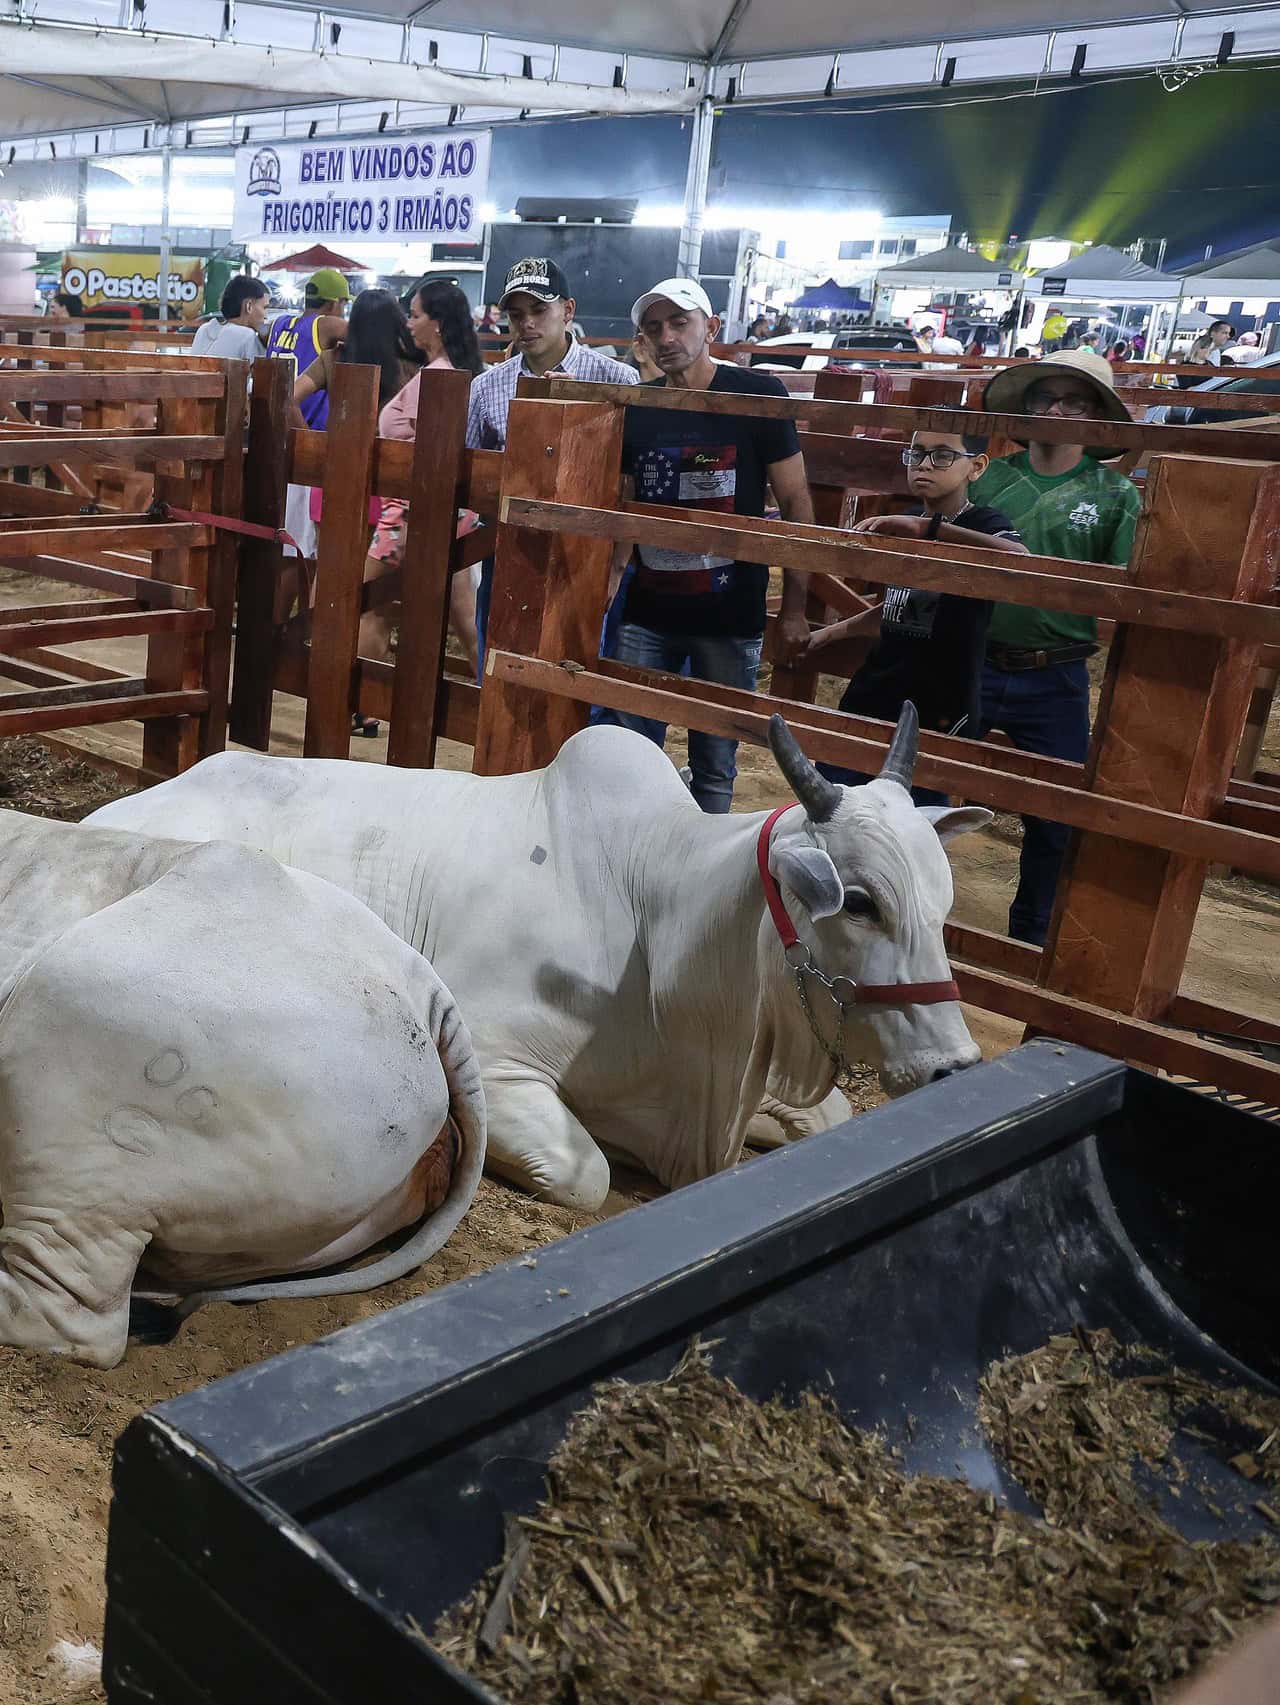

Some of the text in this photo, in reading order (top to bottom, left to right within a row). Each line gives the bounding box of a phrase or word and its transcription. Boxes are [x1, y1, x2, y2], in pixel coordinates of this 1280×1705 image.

[299, 138, 477, 184] BEM VINDOS AO
[262, 187, 474, 234] FRIGORÍFICO 3 IRMÃOS
[885, 587, 911, 607] DENIM
